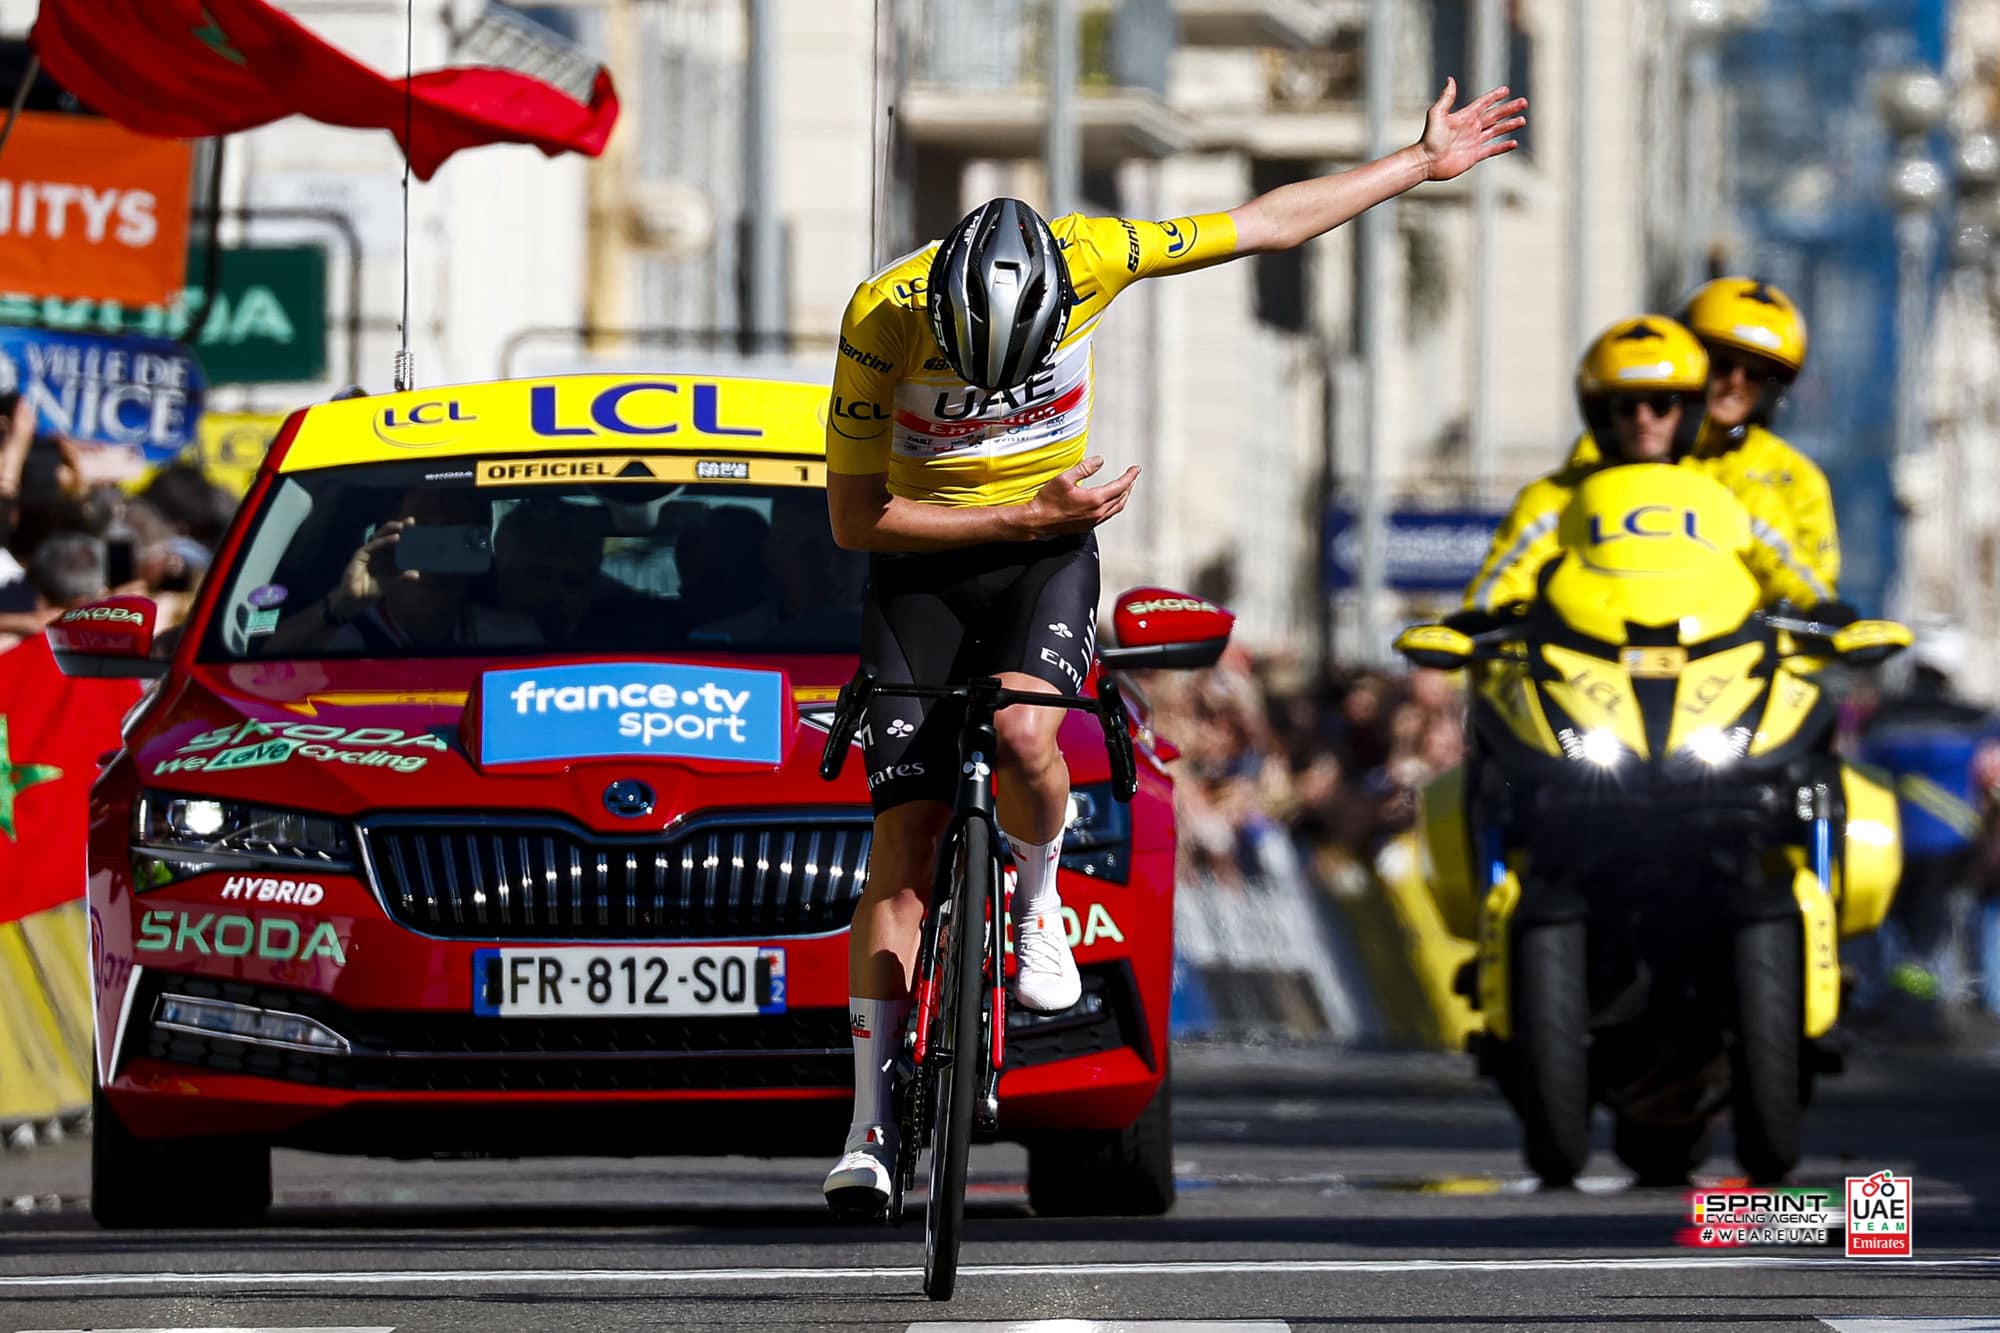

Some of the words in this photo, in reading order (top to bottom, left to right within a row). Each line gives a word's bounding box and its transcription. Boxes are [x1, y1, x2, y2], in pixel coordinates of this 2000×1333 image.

[1154, 219, 1184, 253] LC
[896, 277, 930, 299] LC
[26, 342, 130, 384] VILLE
[134, 353, 191, 389] DE
[834, 395, 891, 420] LCL
[934, 361, 1057, 421] UAE
[24, 376, 190, 448] NICE
[384, 401, 478, 427] LCL
[530, 382, 764, 438] LCL
[488, 462, 611, 480] OFFICIEL
[794, 465, 808, 482] 1
[1589, 505, 1718, 550] LCL
[175, 717, 448, 753] SKODA
[618, 711, 747, 746] sport
[221, 876, 325, 906] HYBRID
[136, 910, 347, 966] SKODA
[509, 955, 747, 1005] FR-812-SQ
[771, 979, 785, 1004] 2
